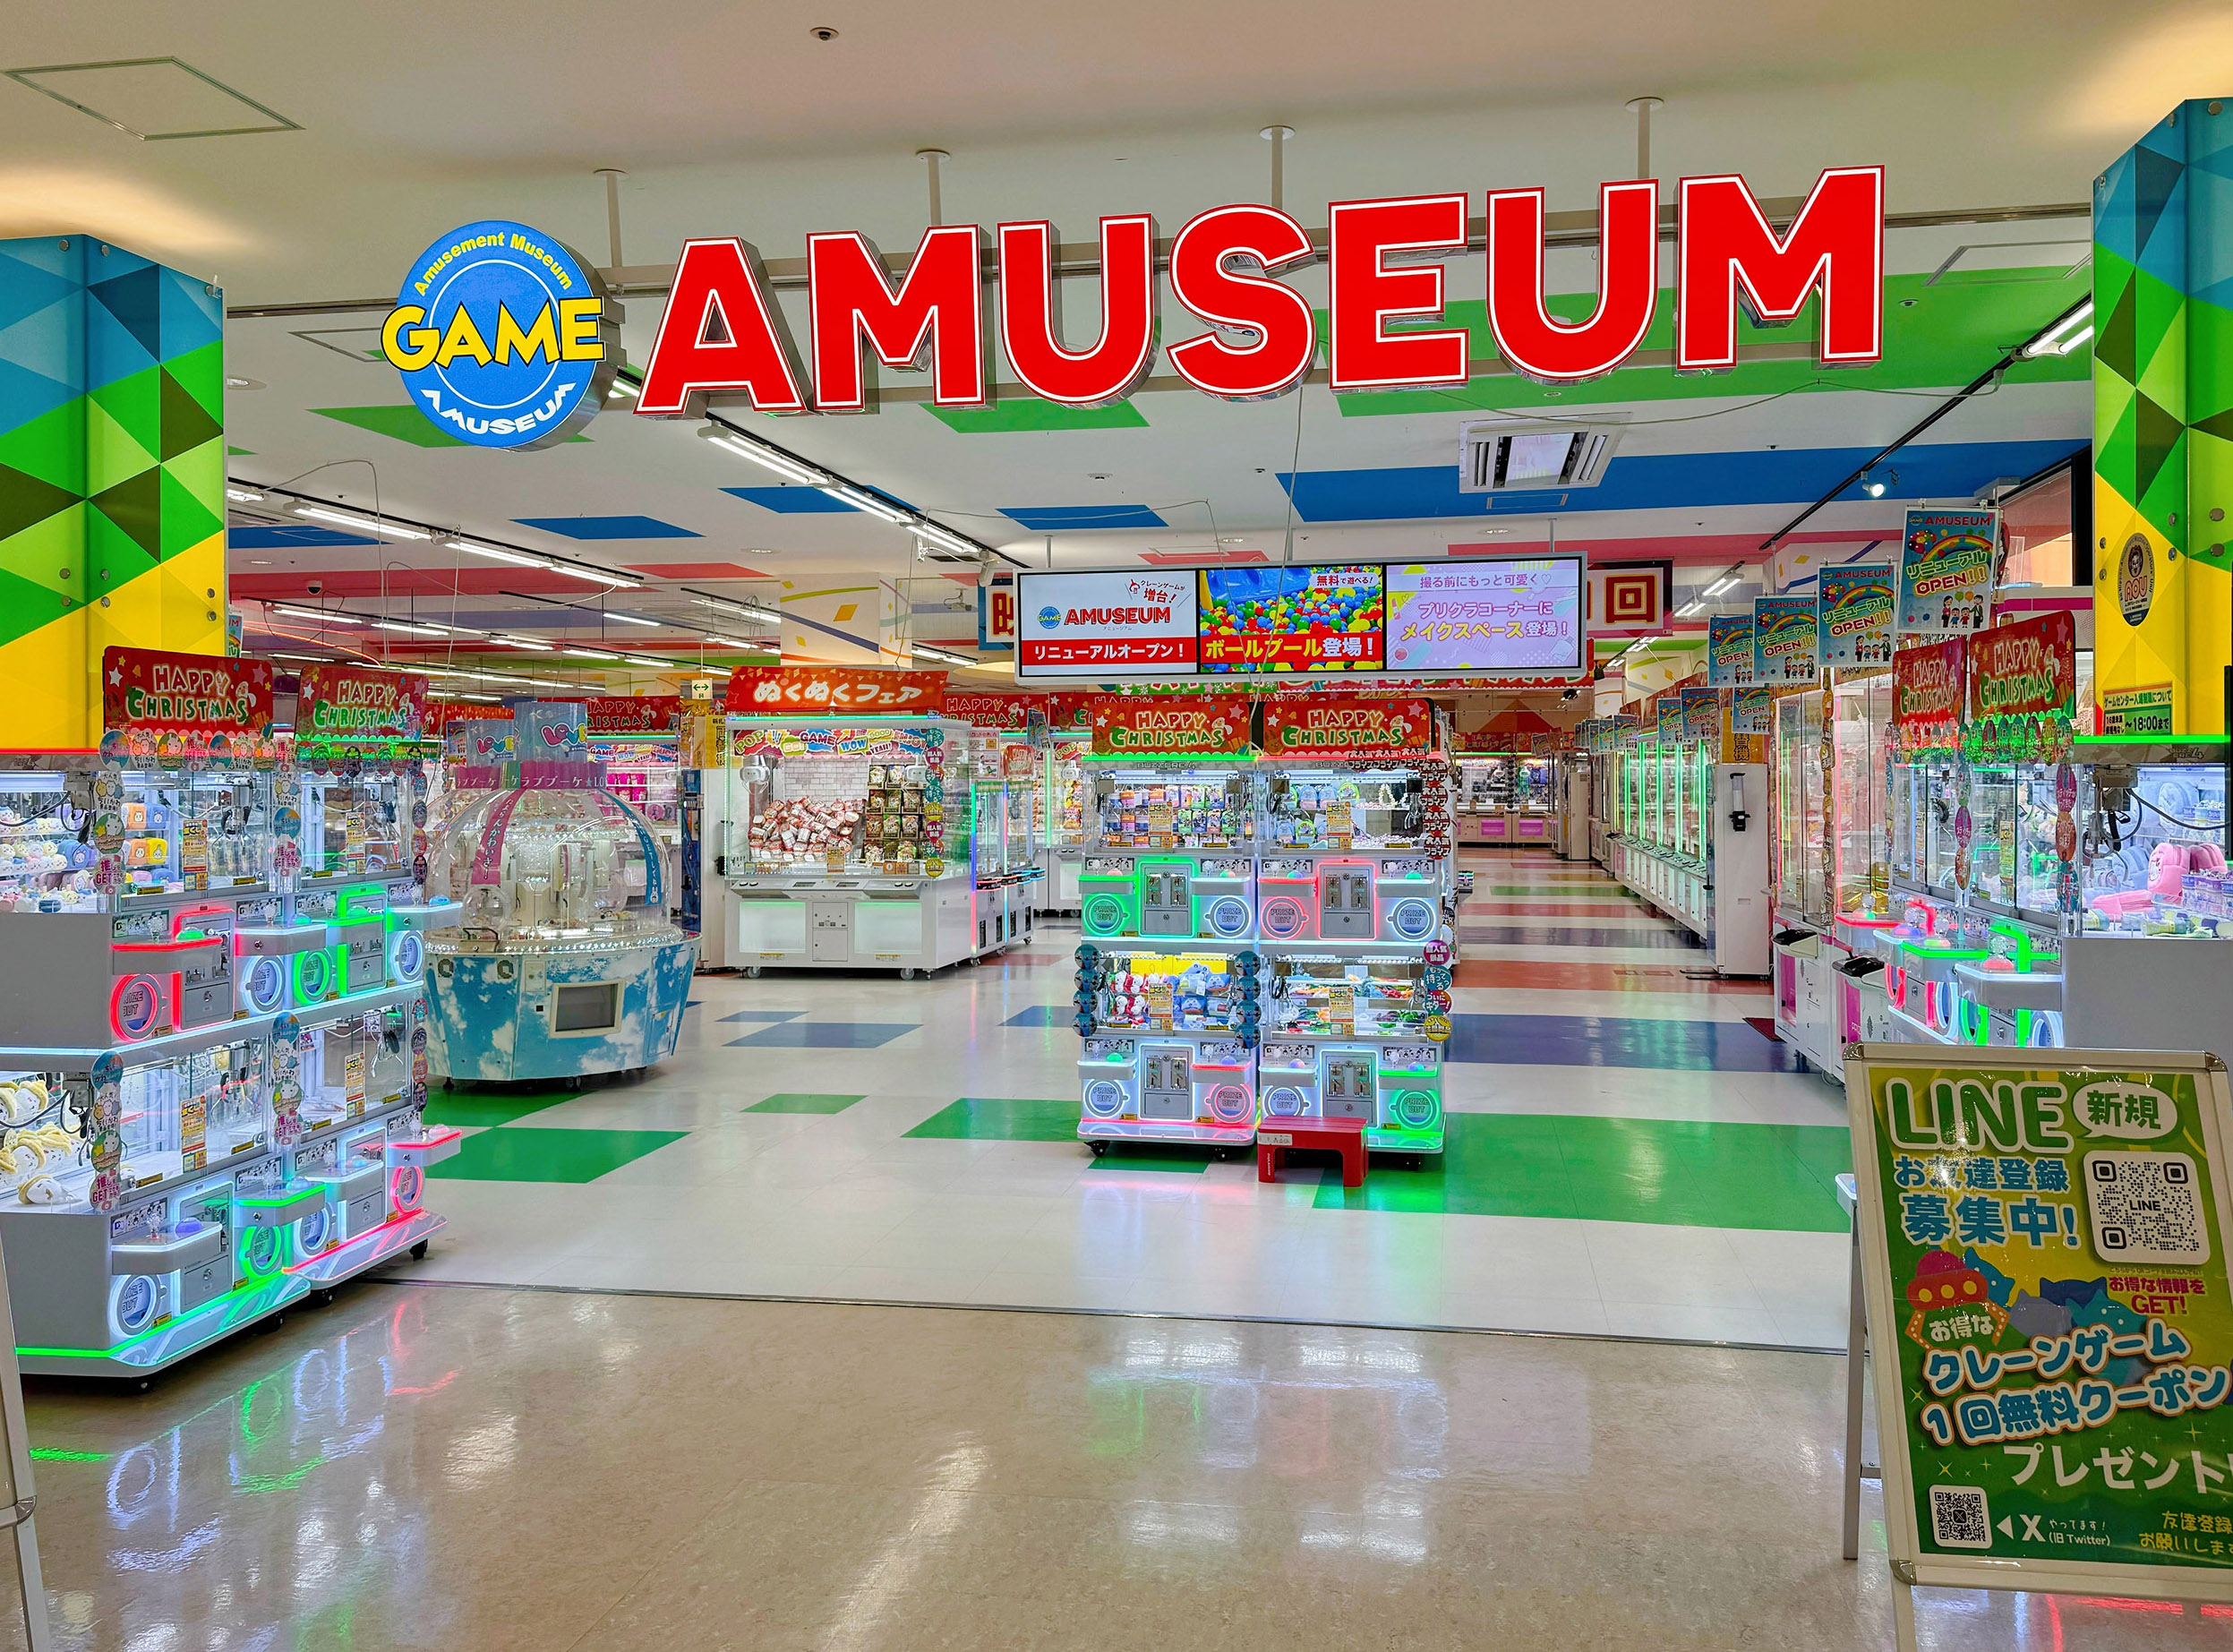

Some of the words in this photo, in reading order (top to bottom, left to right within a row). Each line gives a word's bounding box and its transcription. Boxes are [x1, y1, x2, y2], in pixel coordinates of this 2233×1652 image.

[414, 231, 505, 297] Amusement
[509, 233, 573, 291] Museum
[634, 164, 1886, 416] AMUSEUM
[381, 296, 606, 372] GAME
[1925, 516, 1991, 527] AMUSEUM
[1906, 549, 1988, 579] リニューアル
[1420, 573, 1537, 588] 撮る前にもっと可愛く
[1835, 570, 1892, 579] AMUSEUM
[1913, 566, 1989, 597] OPEN!!
[2125, 575, 2148, 602] AOU
[1418, 601, 1554, 619] プリクラコーナーに
[1767, 601, 1816, 610] AMUSEUM
[1821, 596, 1891, 624] リニューアル
[1037, 613, 1062, 622] GAME
[1064, 606, 1171, 626] AMUSEUM
[1721, 618, 1753, 626] AMUSEU
[1829, 610, 1894, 638] OPEN!!
[1758, 622, 1815, 646] リニューアル
[1034, 644, 1185, 661] リニューアルオープン！
[1205, 638, 1373, 659] ボールプール登場！
[1711, 638, 1753, 656] リニューア
[1763, 634, 1817, 658] OPEN!!
[1993, 635, 2042, 673] HAPPY
[153, 665, 231, 698] HAPPY
[1912, 658, 1947, 689] HAPPY
[337, 680, 398, 706] HAPPY
[752, 680, 924, 704] ぬくぬくフェア
[1979, 665, 2057, 710] CHRISTMAS
[125, 685, 252, 724] CHRISTMAS
[1899, 682, 1956, 715] CHRISTMAS
[313, 698, 410, 731] CHRISTMAS
[587, 715, 651, 728] RISTMAS
[938, 713, 1018, 725] HRISTMAS
[1135, 711, 1207, 730] HAPPY
[1307, 709, 1384, 729] HAPPY
[733, 731, 765, 753] POP
[783, 743, 805, 753] GO!
[800, 731, 836, 746] GAME
[840, 740, 868, 752] WOW
[868, 729, 891, 740] GOOD
[1109, 725, 1226, 748] CHRISTMAS
[1280, 723, 1405, 747] CHRISTMAS
[476, 736, 515, 755] LOVE
[589, 747, 616, 757] GAME
[1056, 744, 1077, 758] POP
[1348, 749, 1374, 758] 大人気
[1374, 749, 1400, 758] 大人気
[1400, 748, 1426, 757] 大人気
[1422, 762, 1448, 771] 大人気
[1422, 787, 1448, 796] 大人気
[1424, 811, 1450, 821] 大人気
[1424, 837, 1450, 846] 大人気
[1093, 906, 1117, 914] PRIZE
[1096, 913, 1114, 921] OUT
[1218, 907, 1242, 915] PRIZE
[1221, 915, 1238, 923] OUT
[1270, 908, 1296, 916] PRIZE
[1400, 908, 1426, 917] PRIZE
[1274, 916, 1291, 924] OUT
[1404, 916, 1422, 925] OUT
[124, 990, 143, 1005] RIZE
[1092, 1086, 1116, 1095] PRIZE
[1096, 1094, 1113, 1102] OUT
[1218, 1091, 1243, 1100] PRIZE
[1273, 1092, 1296, 1100] PRIZE
[1221, 1099, 1238, 1107] OUT
[1277, 1100, 1293, 1108] OUT
[1404, 1097, 1428, 1105] PRIZE
[1408, 1105, 1425, 1113] OUT
[2086, 1090, 2162, 1129] 新規
[1889, 1080, 2073, 1150] LINE
[2128, 1198, 2161, 1212] LINE
[1900, 1194, 2082, 1247] 募集中！
[124, 1280, 143, 1295] RIZE
[2109, 1277, 2206, 1295] お得な情報を
[2131, 1295, 2188, 1314] GET!
[1929, 1314, 1996, 1342] お得な
[1925, 1319, 2192, 1394] クレーンゲーム
[1922, 1366, 2230, 1444] １回無料クーポン
[2020, 1514, 2046, 1543] X
[2049, 1519, 2107, 1531] やってます！
[2161, 1510, 2233, 1536] 友達登録
[2066, 1534, 2111, 1547] Twitter)
